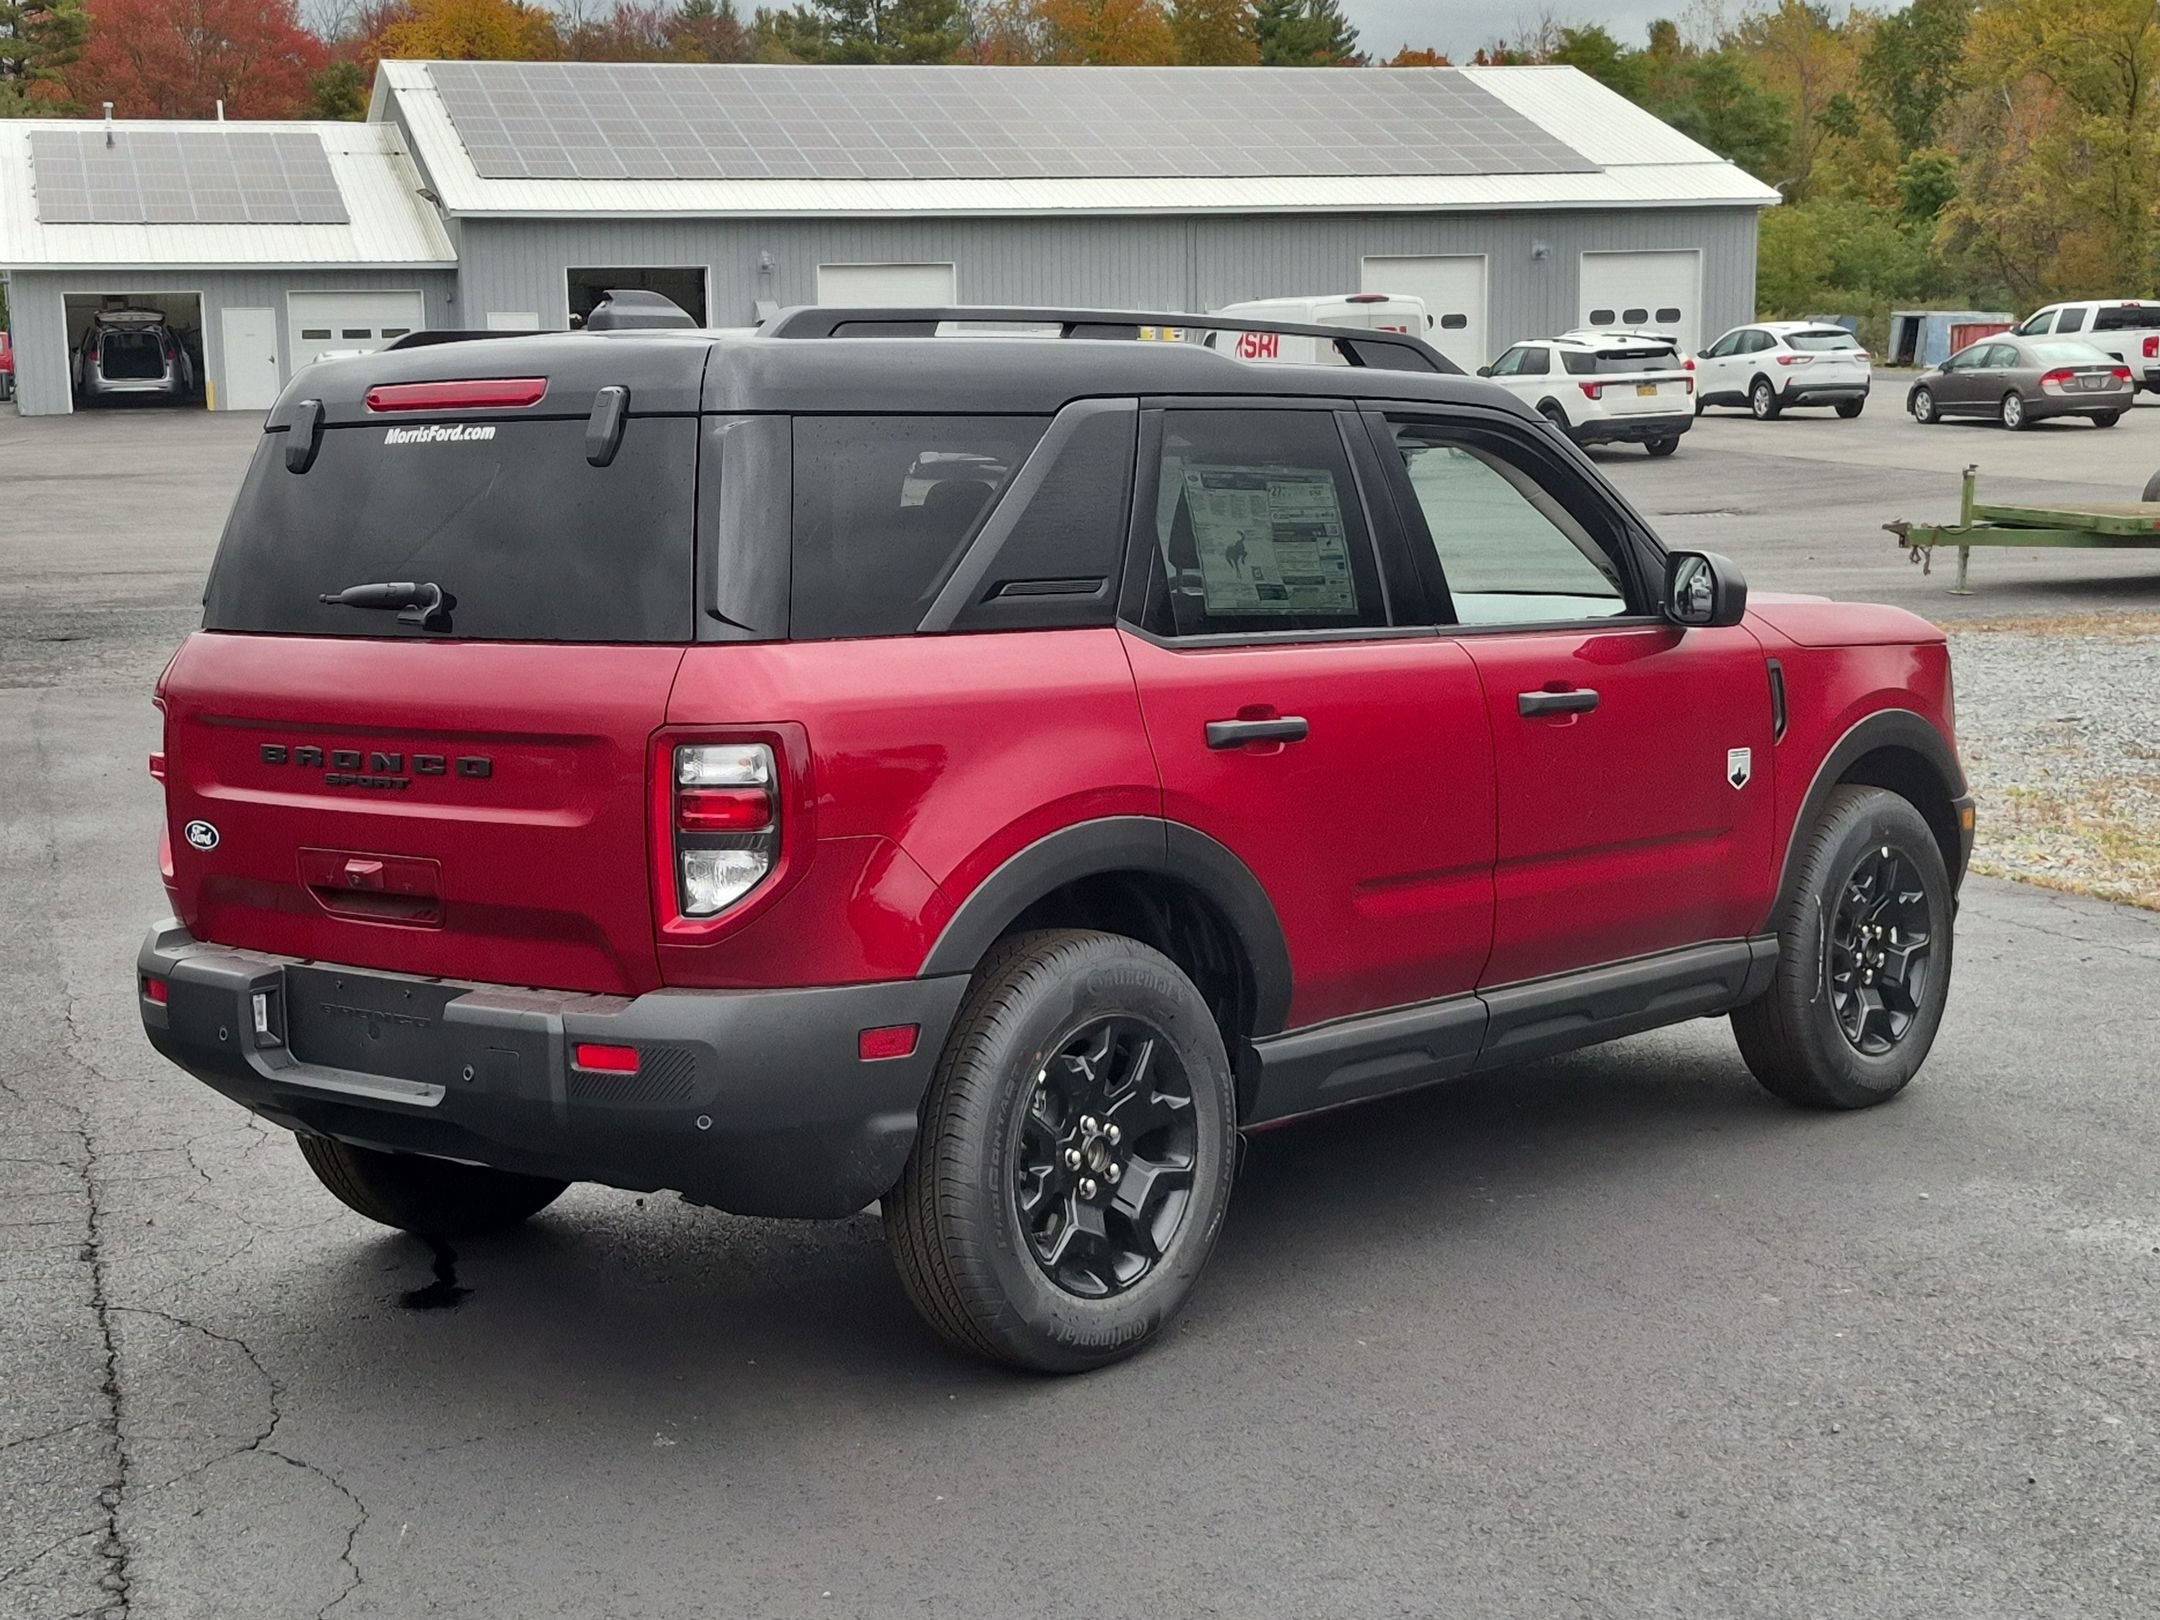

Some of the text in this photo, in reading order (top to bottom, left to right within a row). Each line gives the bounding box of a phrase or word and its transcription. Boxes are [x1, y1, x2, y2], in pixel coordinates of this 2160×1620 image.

[384, 424, 496, 444] MorrisFord.com
[260, 743, 493, 778] BRONCO
[325, 773, 412, 789] SPORT
[189, 823, 214, 846] Ford
